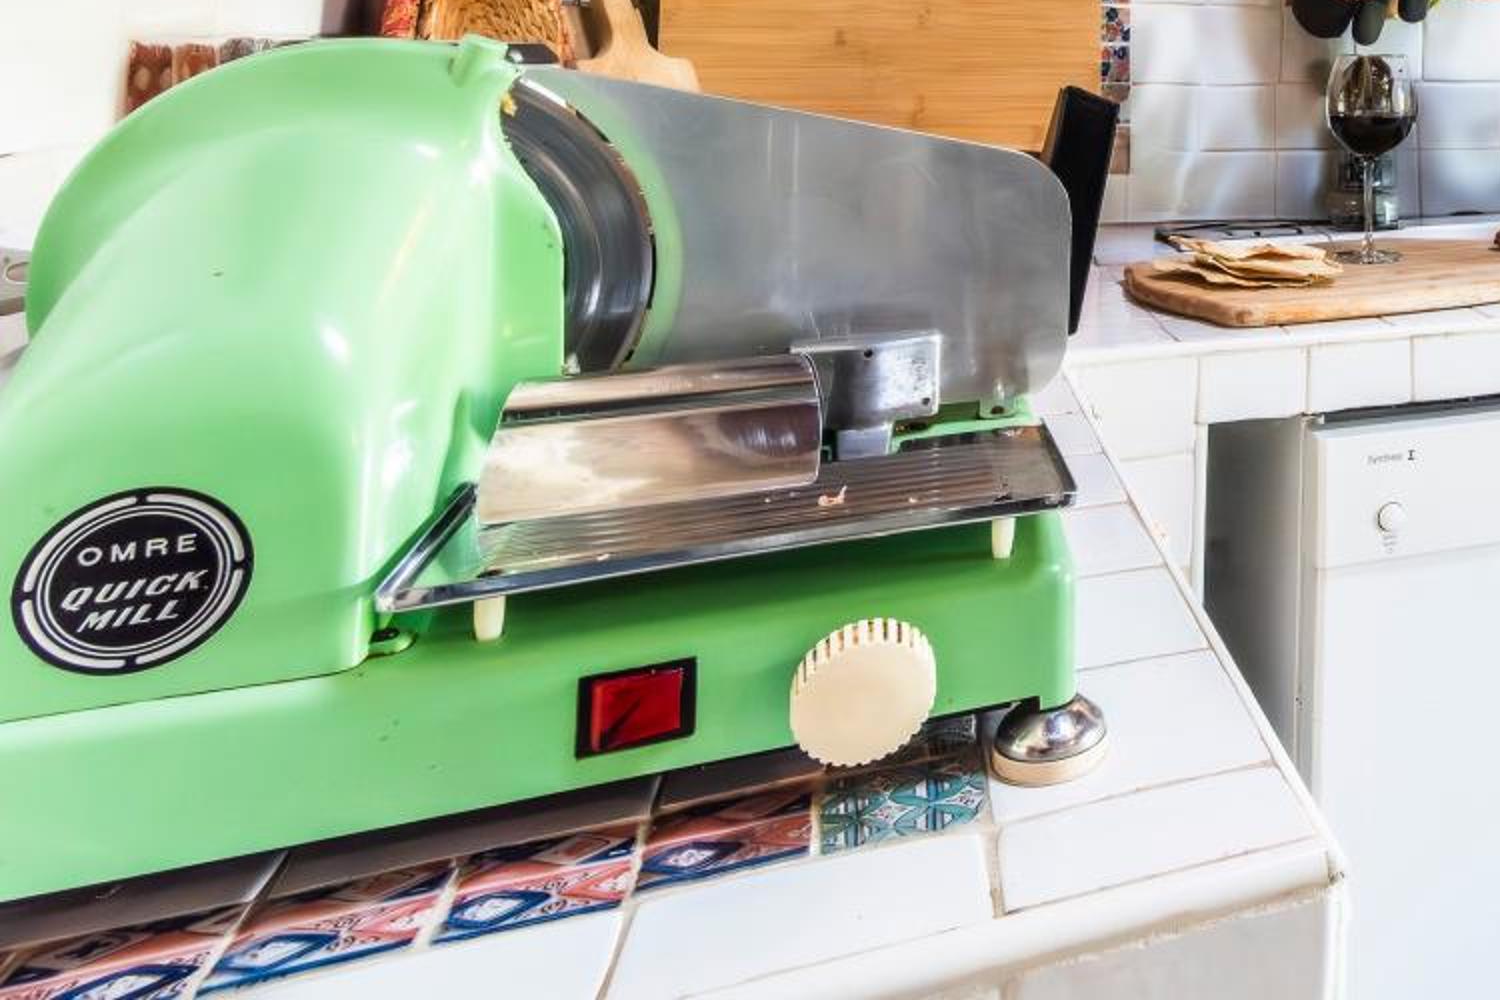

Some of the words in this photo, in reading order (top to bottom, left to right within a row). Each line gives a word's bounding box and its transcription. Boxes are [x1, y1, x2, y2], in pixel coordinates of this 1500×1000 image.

[77, 533, 197, 567] OMRE
[60, 569, 208, 611] QUICK
[76, 600, 179, 633] MILL
